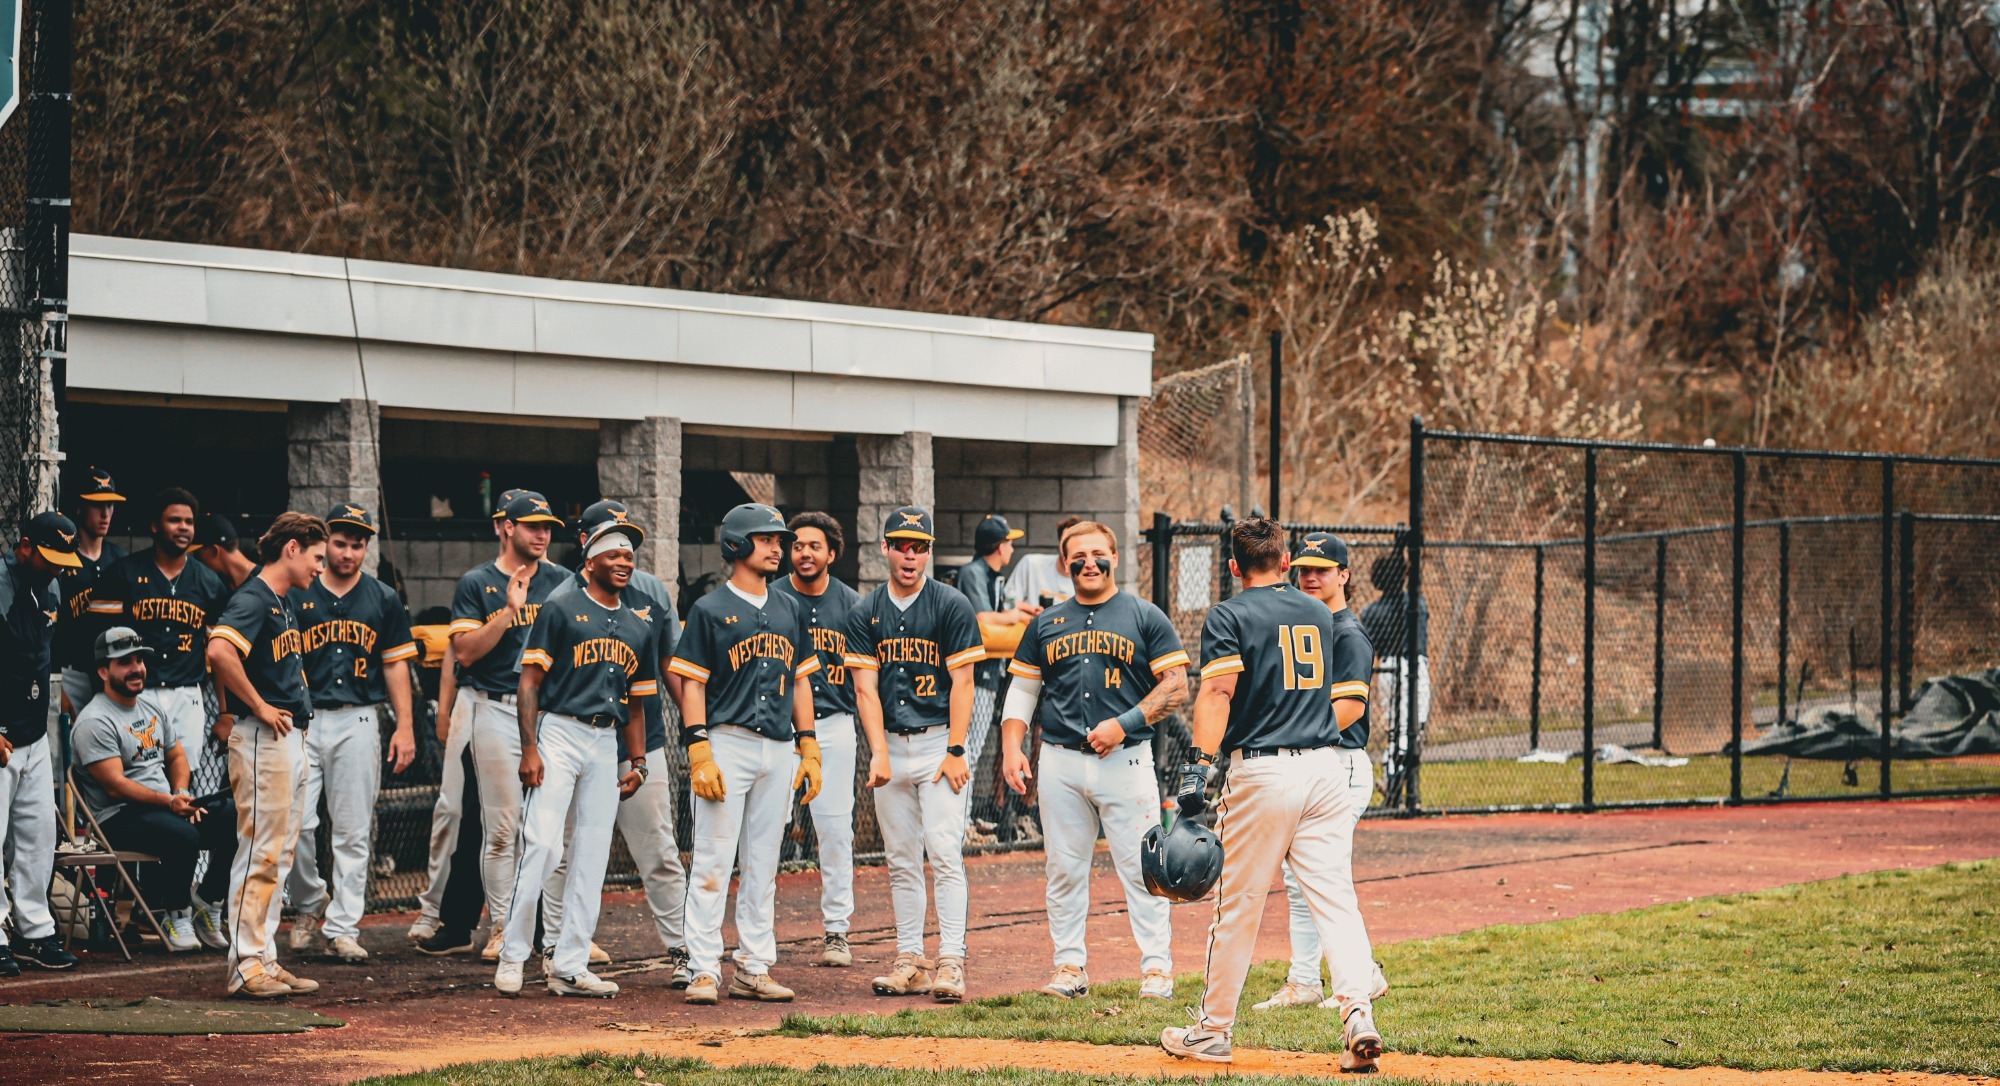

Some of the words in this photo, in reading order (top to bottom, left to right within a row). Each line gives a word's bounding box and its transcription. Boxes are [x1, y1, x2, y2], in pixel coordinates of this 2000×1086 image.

[301, 619, 378, 655] WESTCHESTER
[1046, 630, 1135, 666] WESTCHESTER
[354, 657, 368, 678] 12
[1278, 624, 1325, 690] 19
[826, 663, 845, 685] 20
[915, 674, 937, 697] 22
[1104, 667, 1122, 689] 14
